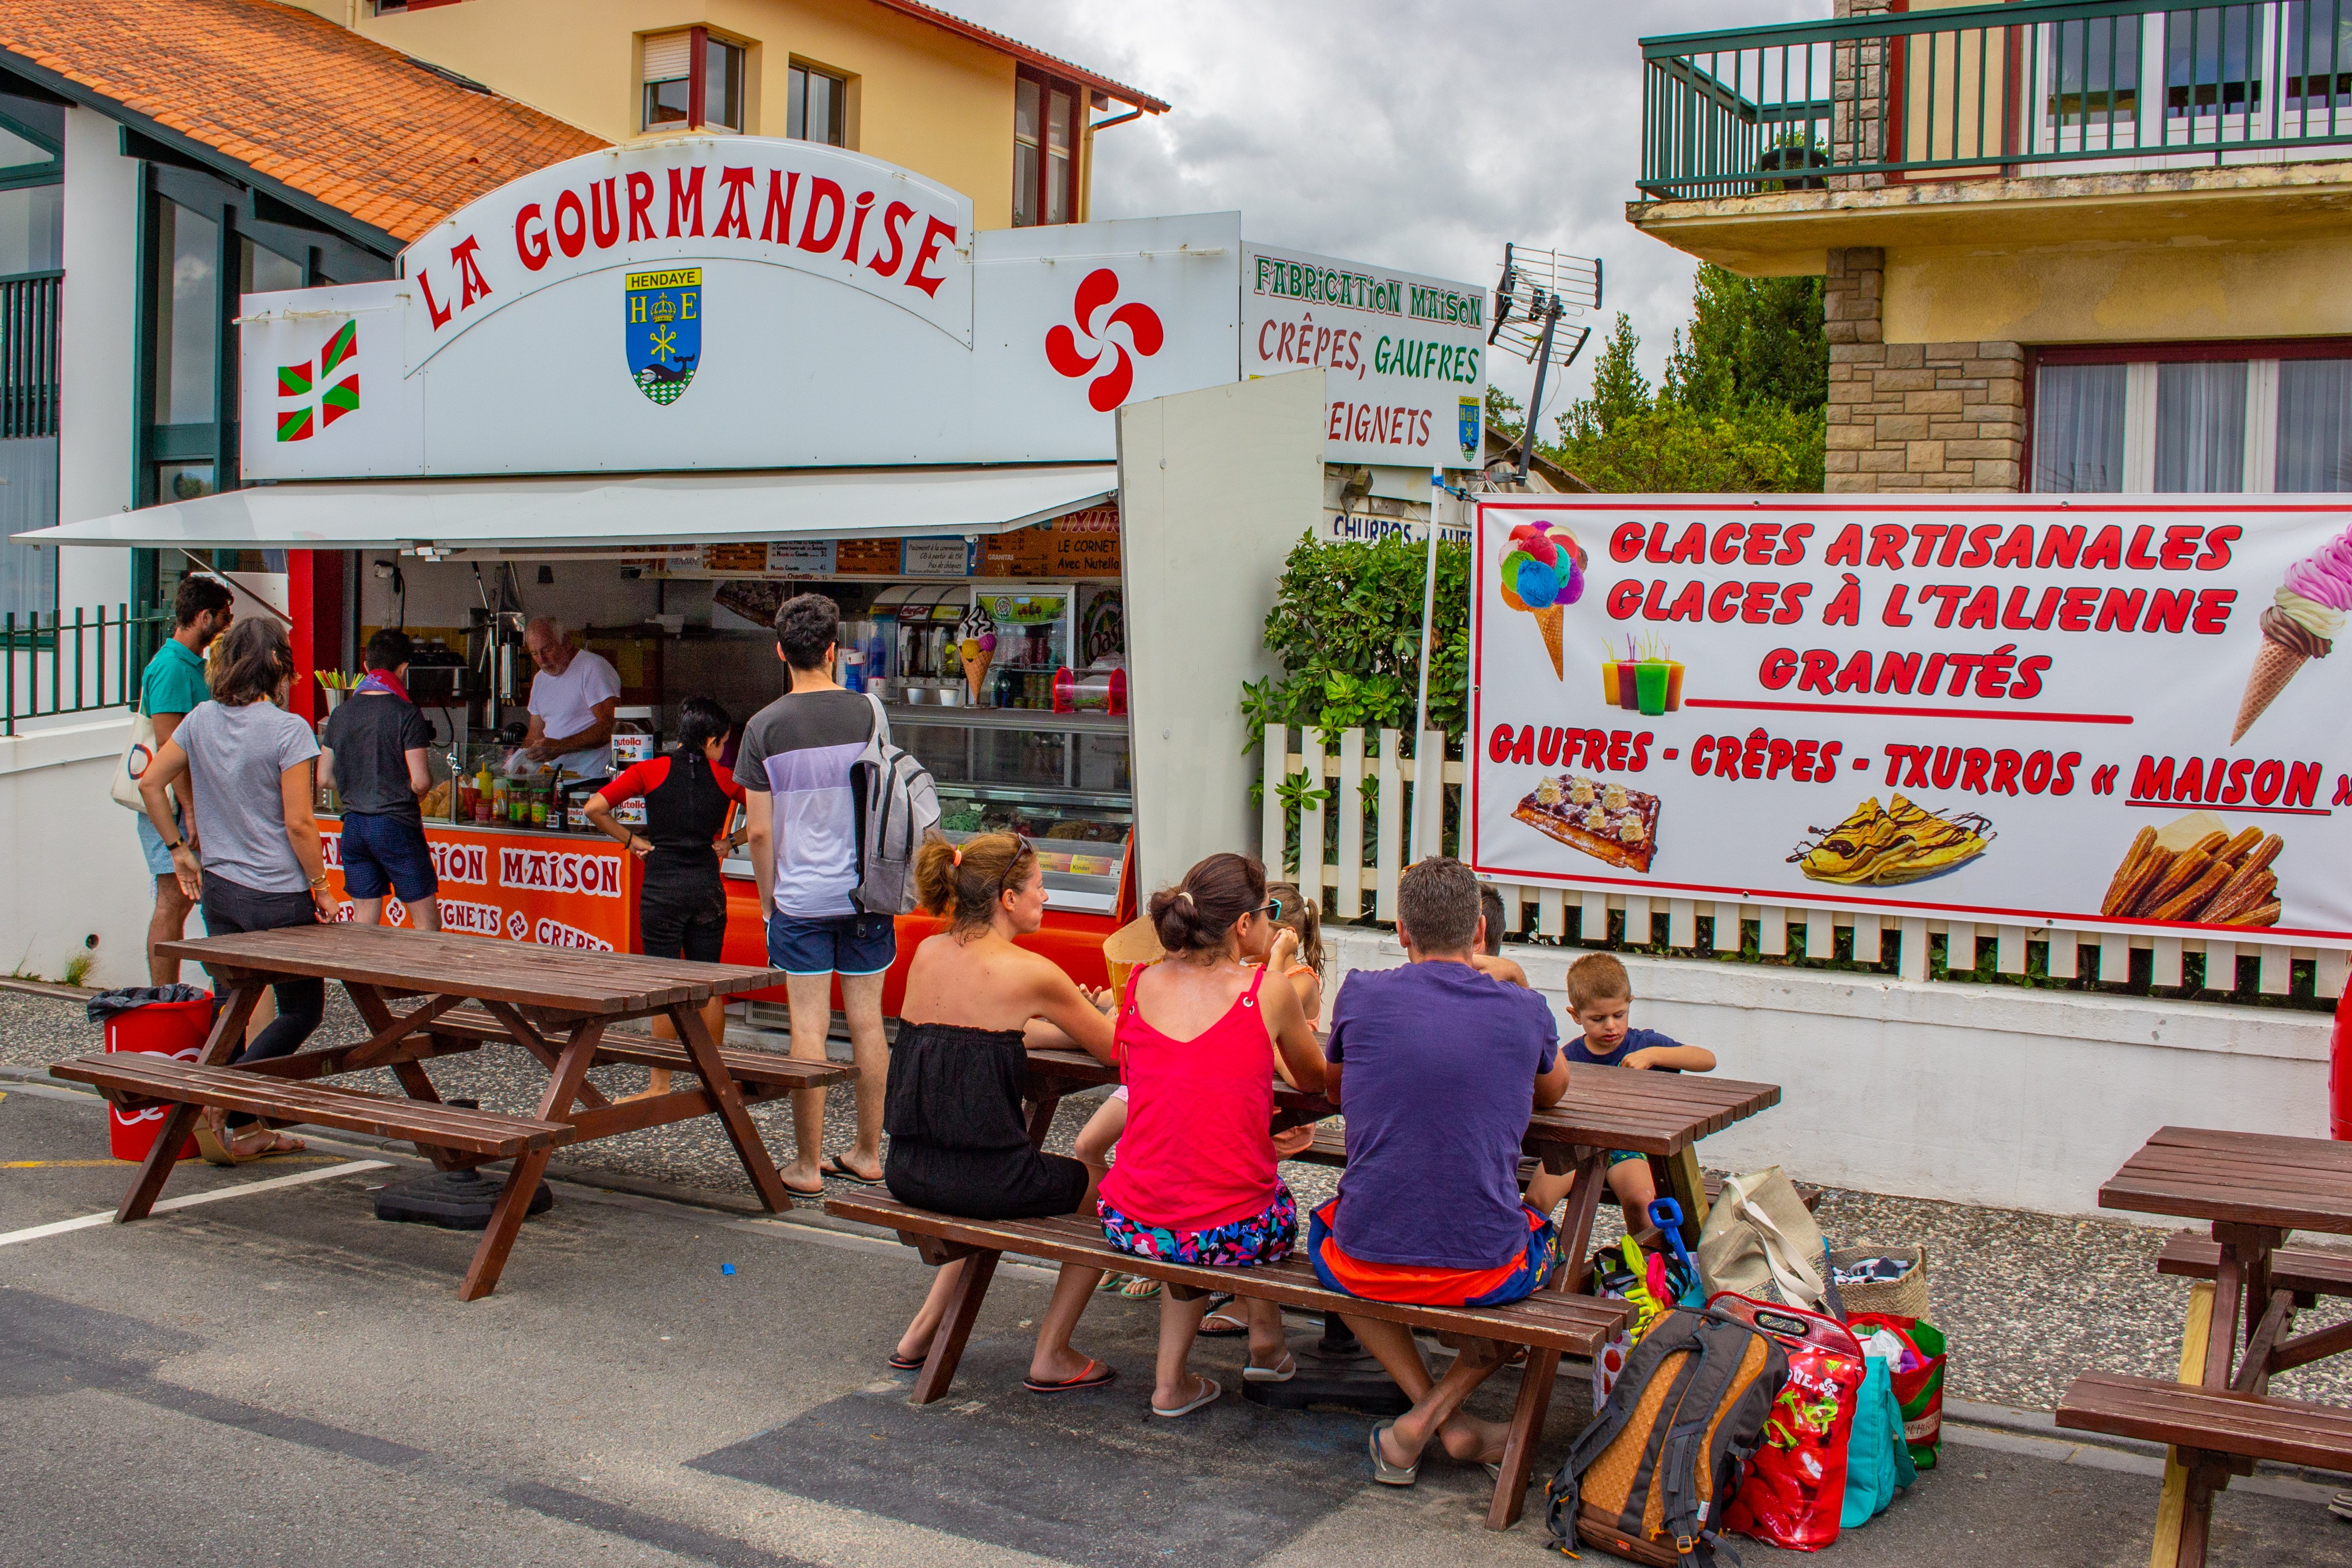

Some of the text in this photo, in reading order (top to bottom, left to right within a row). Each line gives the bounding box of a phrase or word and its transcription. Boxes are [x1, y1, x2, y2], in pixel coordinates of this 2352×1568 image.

[417, 234, 493, 333] LA
[631, 271, 695, 288] HENDAYE
[629, 292, 697, 324] H E
[1258, 312, 1479, 384] CRÊPES, GAUFRES
[1324, 401, 1433, 447] EIGNETS
[1058, 539, 1117, 553] LE CORNET
[1334, 515, 1411, 546] CHURROS
[1609, 522, 2243, 572] GLACES ARTISANALES
[931, 553, 946, 562] partir
[944, 561, 962, 572] chèques
[1057, 557, 1119, 570] Avec Nutella
[1606, 573, 2238, 635] GLACES À L'TALIENNE
[1088, 610, 1123, 661] Oasi
[1758, 644, 2053, 700] GRANITÉS
[614, 737, 642, 747] nutella
[1488, 724, 1655, 773] GAUFRES
[1690, 727, 1843, 784] CRÊPES
[1884, 744, 2082, 798] TXURROS
[2129, 755, 2323, 807] MAISON
